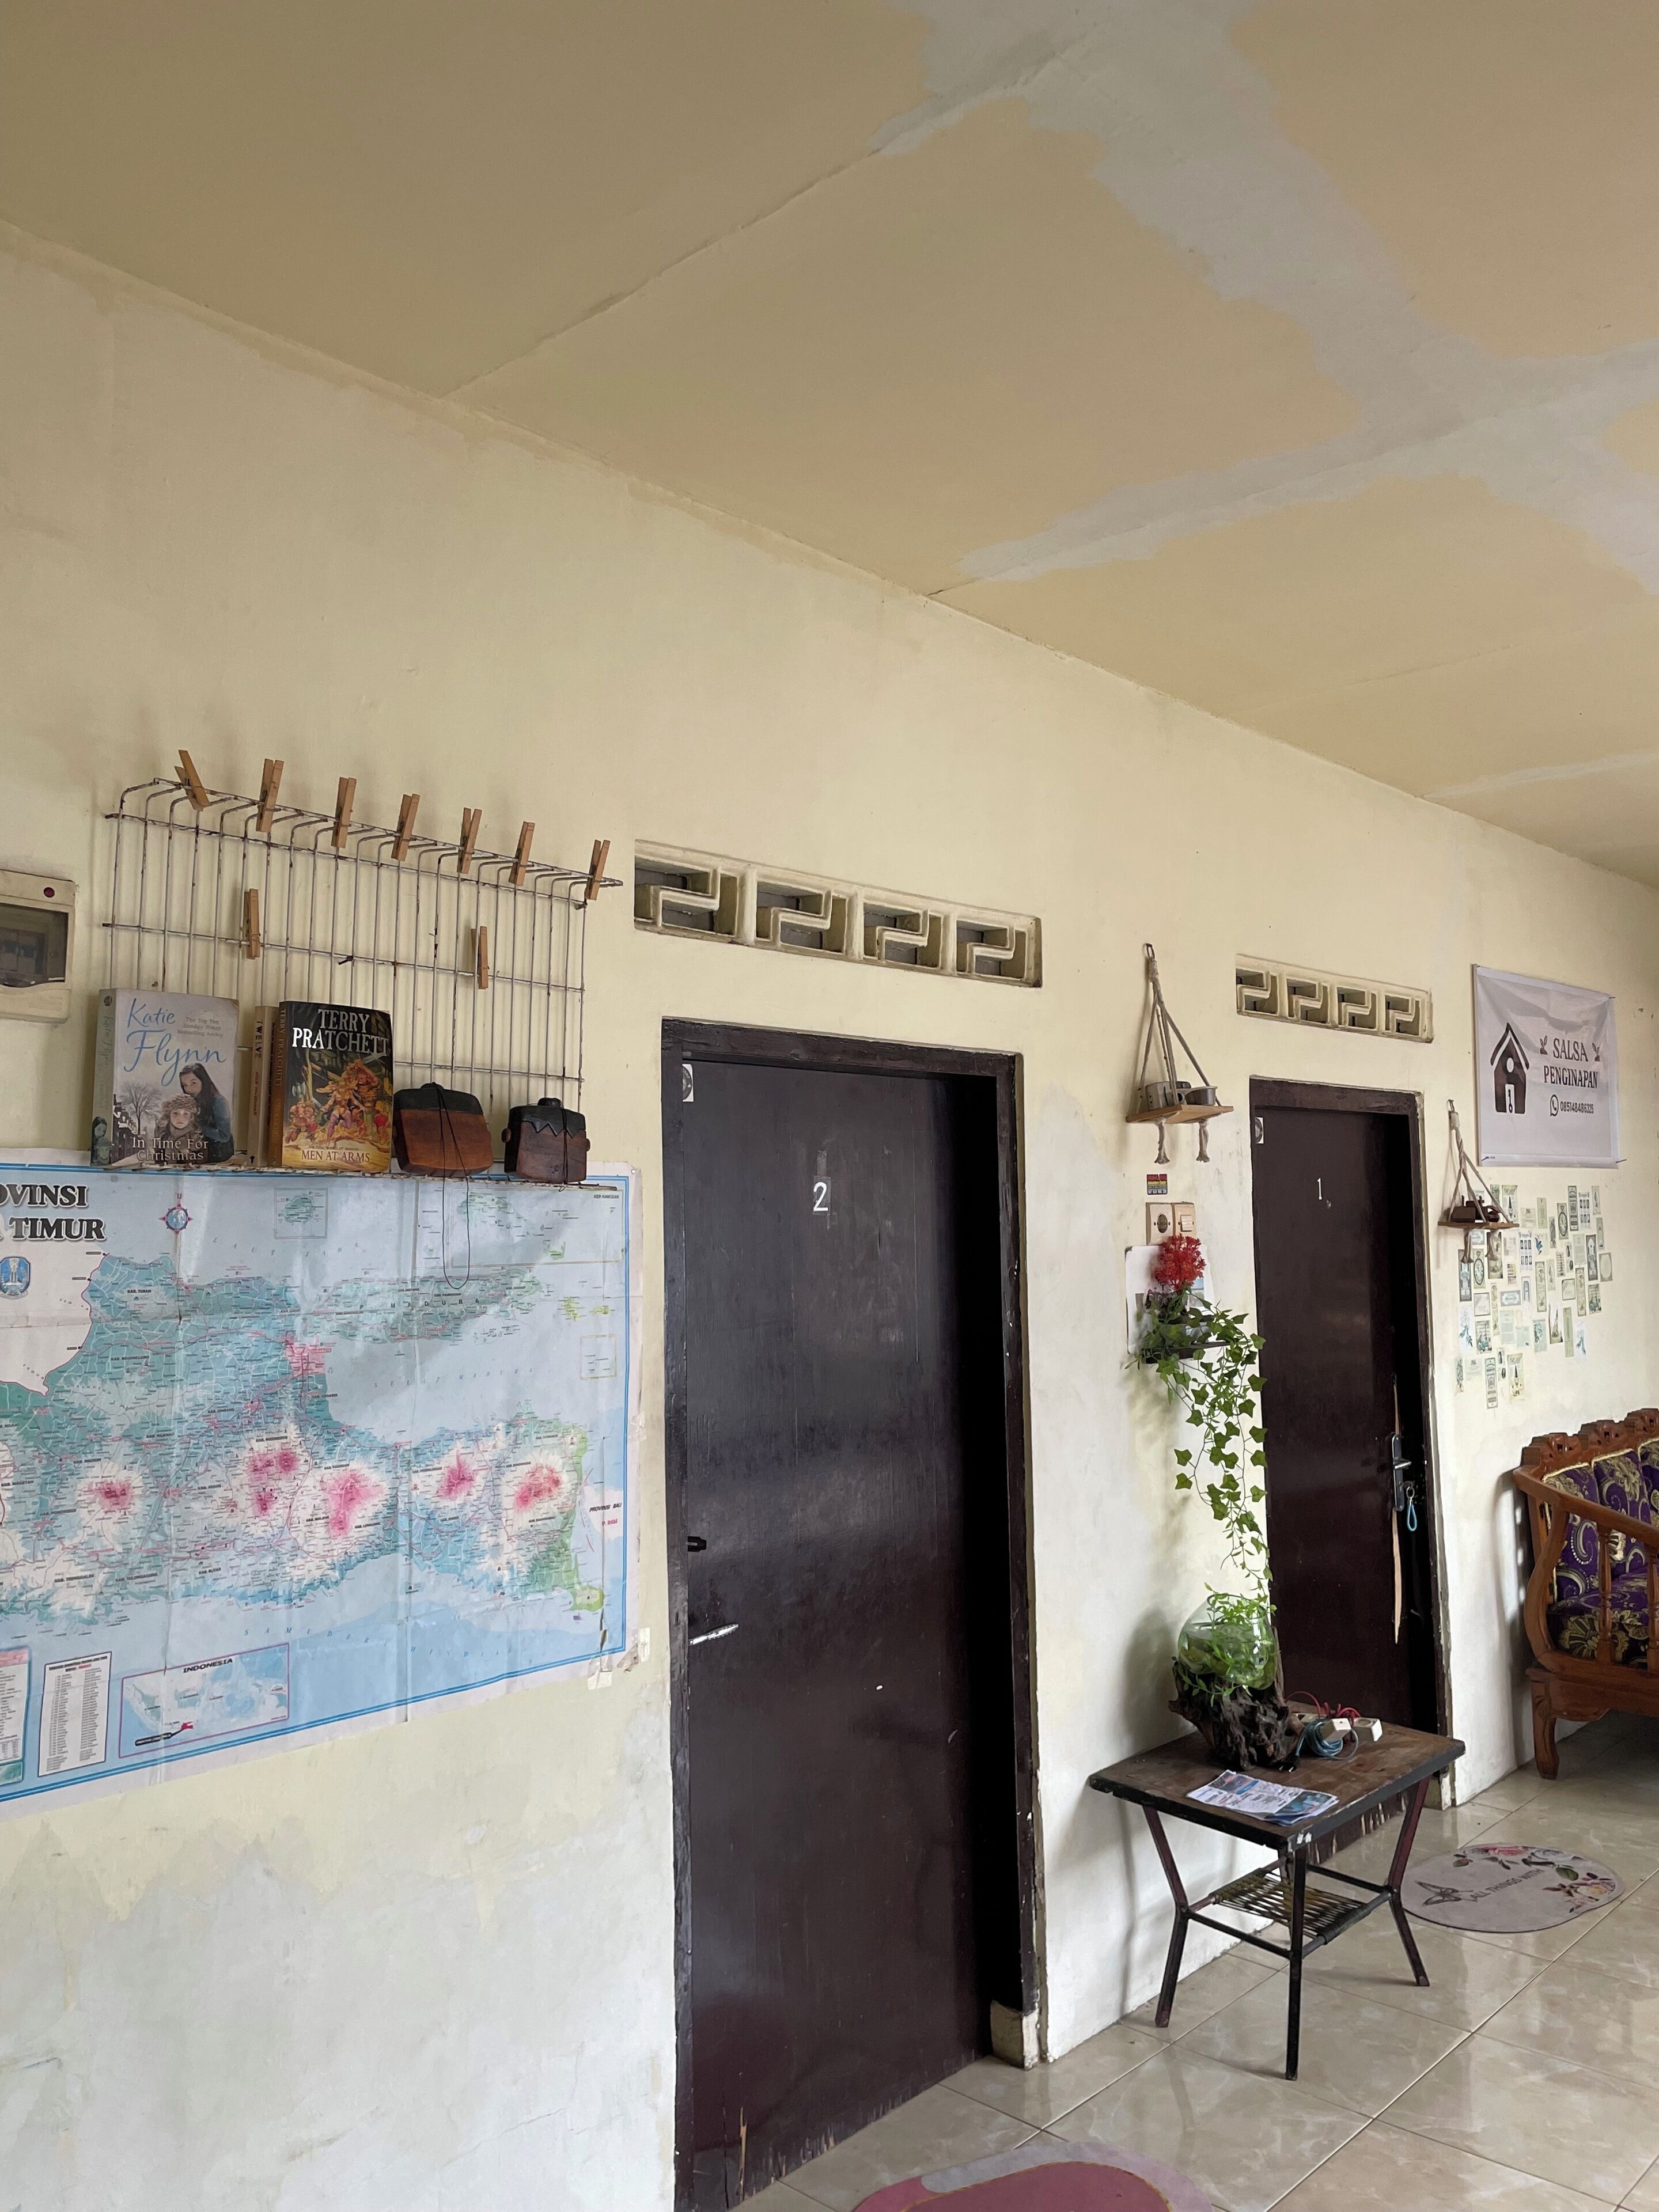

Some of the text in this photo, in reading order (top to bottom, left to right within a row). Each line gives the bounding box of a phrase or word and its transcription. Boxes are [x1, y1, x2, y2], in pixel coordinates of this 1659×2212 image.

[127, 998, 176, 1028] Katie
[318, 1009, 370, 1033] TERRY
[255, 1018, 263, 1059] TWELVE
[291, 1028, 389, 1057] PRATCHETT
[1553, 1037, 1589, 1062] SALSA
[124, 1029, 226, 1086] Flynn
[1544, 1066, 1598, 1089] PENGINAPAN
[132, 1138, 209, 1149] In Time For
[137, 1150, 204, 1162] Christmas
[301, 1150, 370, 1162] MEN AT ARMS
[813, 1181, 828, 1211] 2
[1317, 1177, 1322, 1200] 1
[9, 1217, 105, 1240] TIMUR
[183, 1658, 233, 1673] INDONESIA
[1470, 1891, 1491, 1902] ALL
